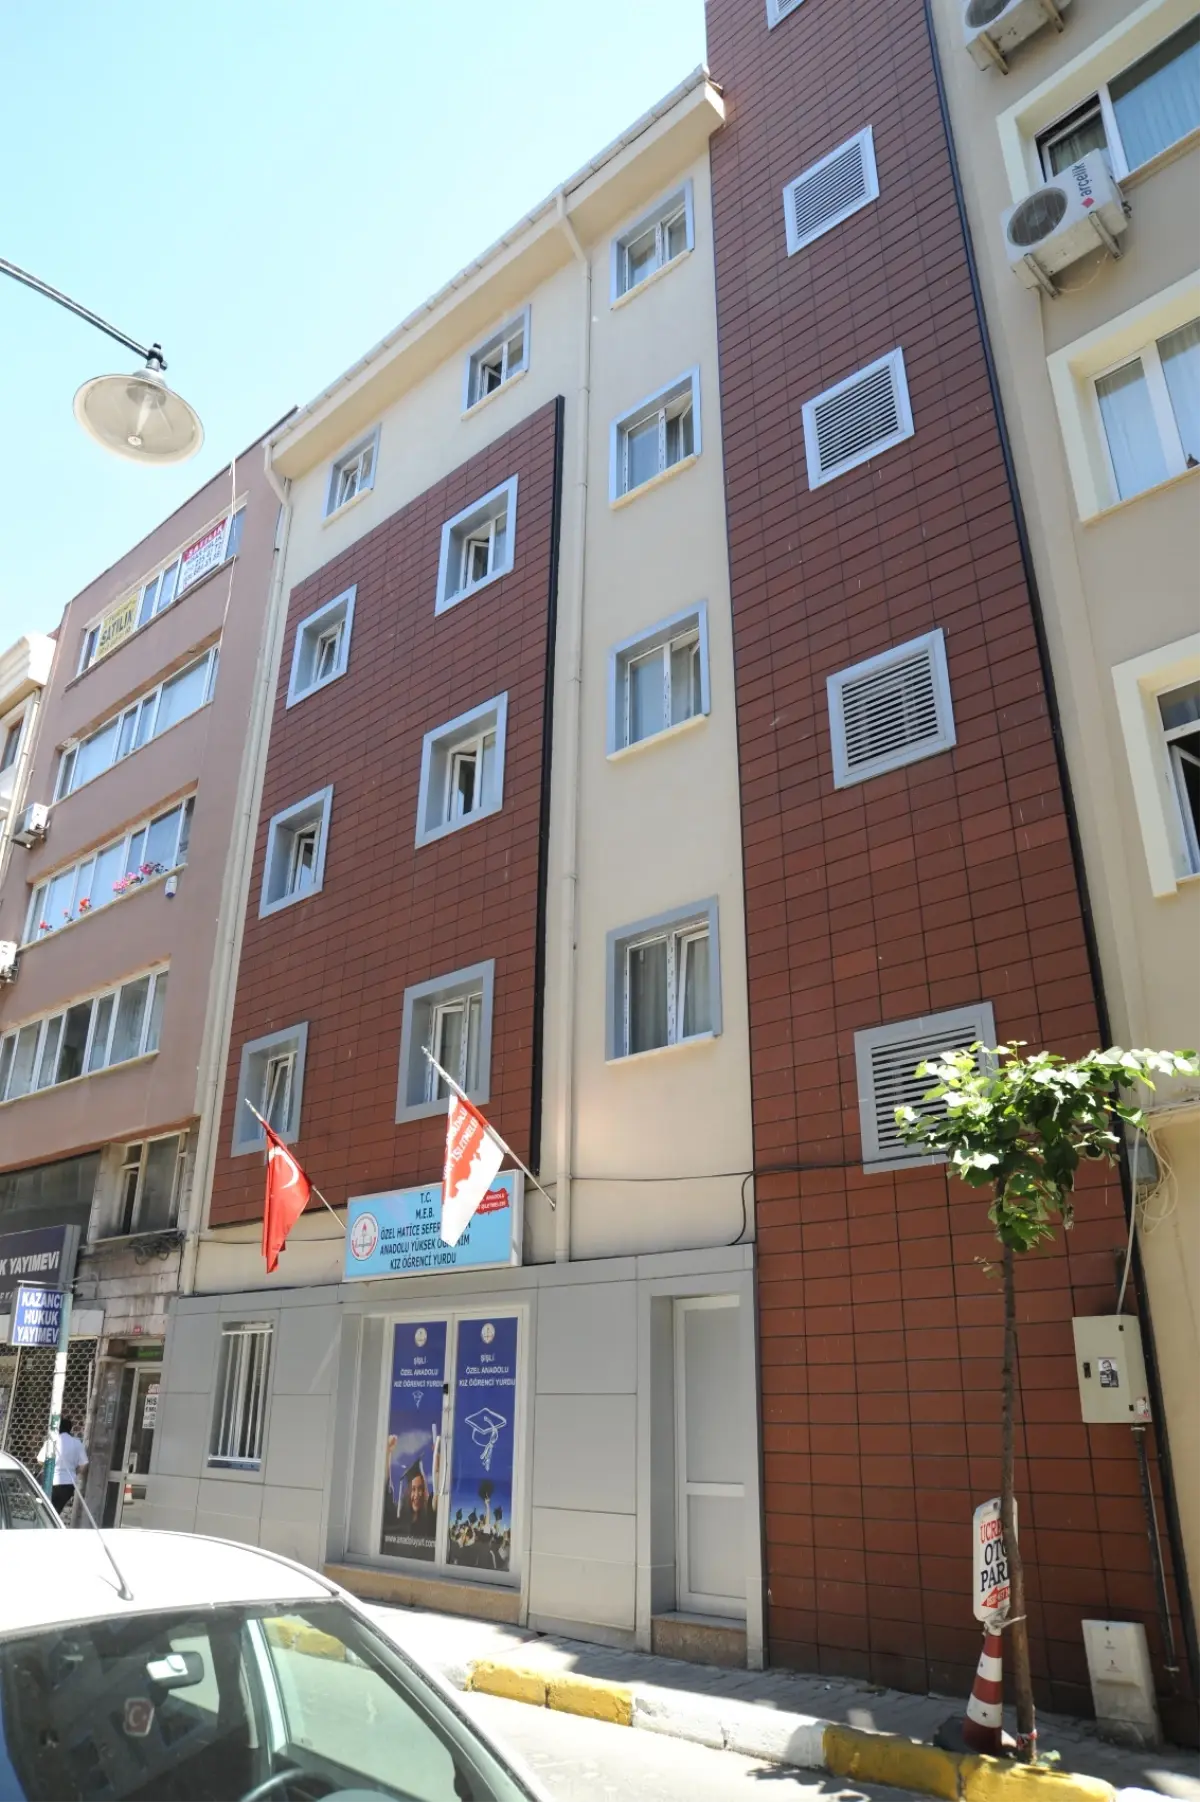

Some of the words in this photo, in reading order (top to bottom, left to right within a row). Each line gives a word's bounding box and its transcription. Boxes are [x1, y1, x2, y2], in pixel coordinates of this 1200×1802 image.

[1071, 162, 1093, 197] arçelik
[420, 1192, 432, 1204] T.C.
[415, 1208, 435, 1220] M.E.B.
[381, 1225, 396, 1241] ÖZEL
[397, 1221, 421, 1238] HATİCE
[379, 1241, 410, 1256] ANADOLU
[411, 1237, 436, 1253] YÜKSEK
[390, 1258, 401, 1270] KIZ
[402, 1253, 431, 1269] ÖĞRENCİ
[432, 1252, 457, 1266] YURDU
[24, 1308, 58, 1325] HUKUK
[17, 1325, 60, 1343] YAYIMEV
[480, 1354, 495, 1363] ŞİŞLİ
[400, 1368, 413, 1376] ÖZEL
[414, 1368, 439, 1376] ANADOLU
[466, 1366, 480, 1374] ÖZEL
[481, 1366, 509, 1374] ANADOLU
[394, 1380, 402, 1388] KIZ
[403, 1379, 426, 1388] ÖĞRENCİ
[427, 1379, 444, 1387] YURDU
[459, 1379, 468, 1387] KIZ
[469, 1378, 494, 1387] ÖĞRENCİ
[495, 1378, 517, 1386] YURDU
